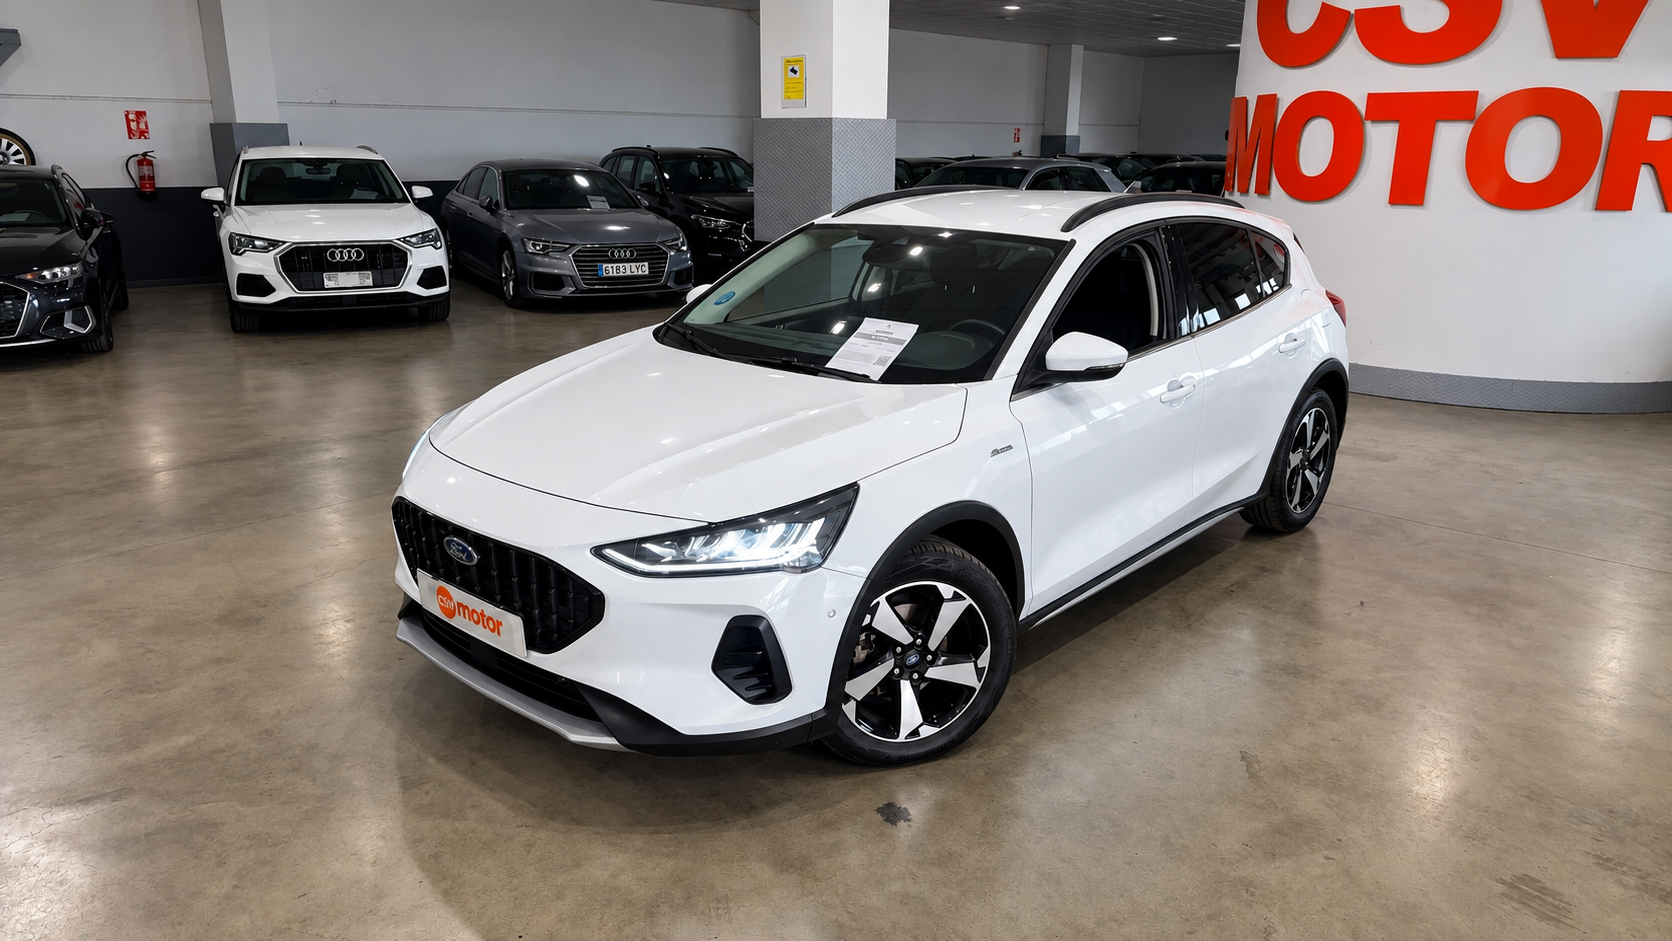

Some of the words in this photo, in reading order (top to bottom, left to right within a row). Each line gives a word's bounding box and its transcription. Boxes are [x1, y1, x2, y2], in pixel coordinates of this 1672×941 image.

[1226, 86, 1672, 212] MOTOR
[604, 264, 627, 275] 6183
[629, 263, 647, 274] LYC
[456, 601, 503, 636] motor
